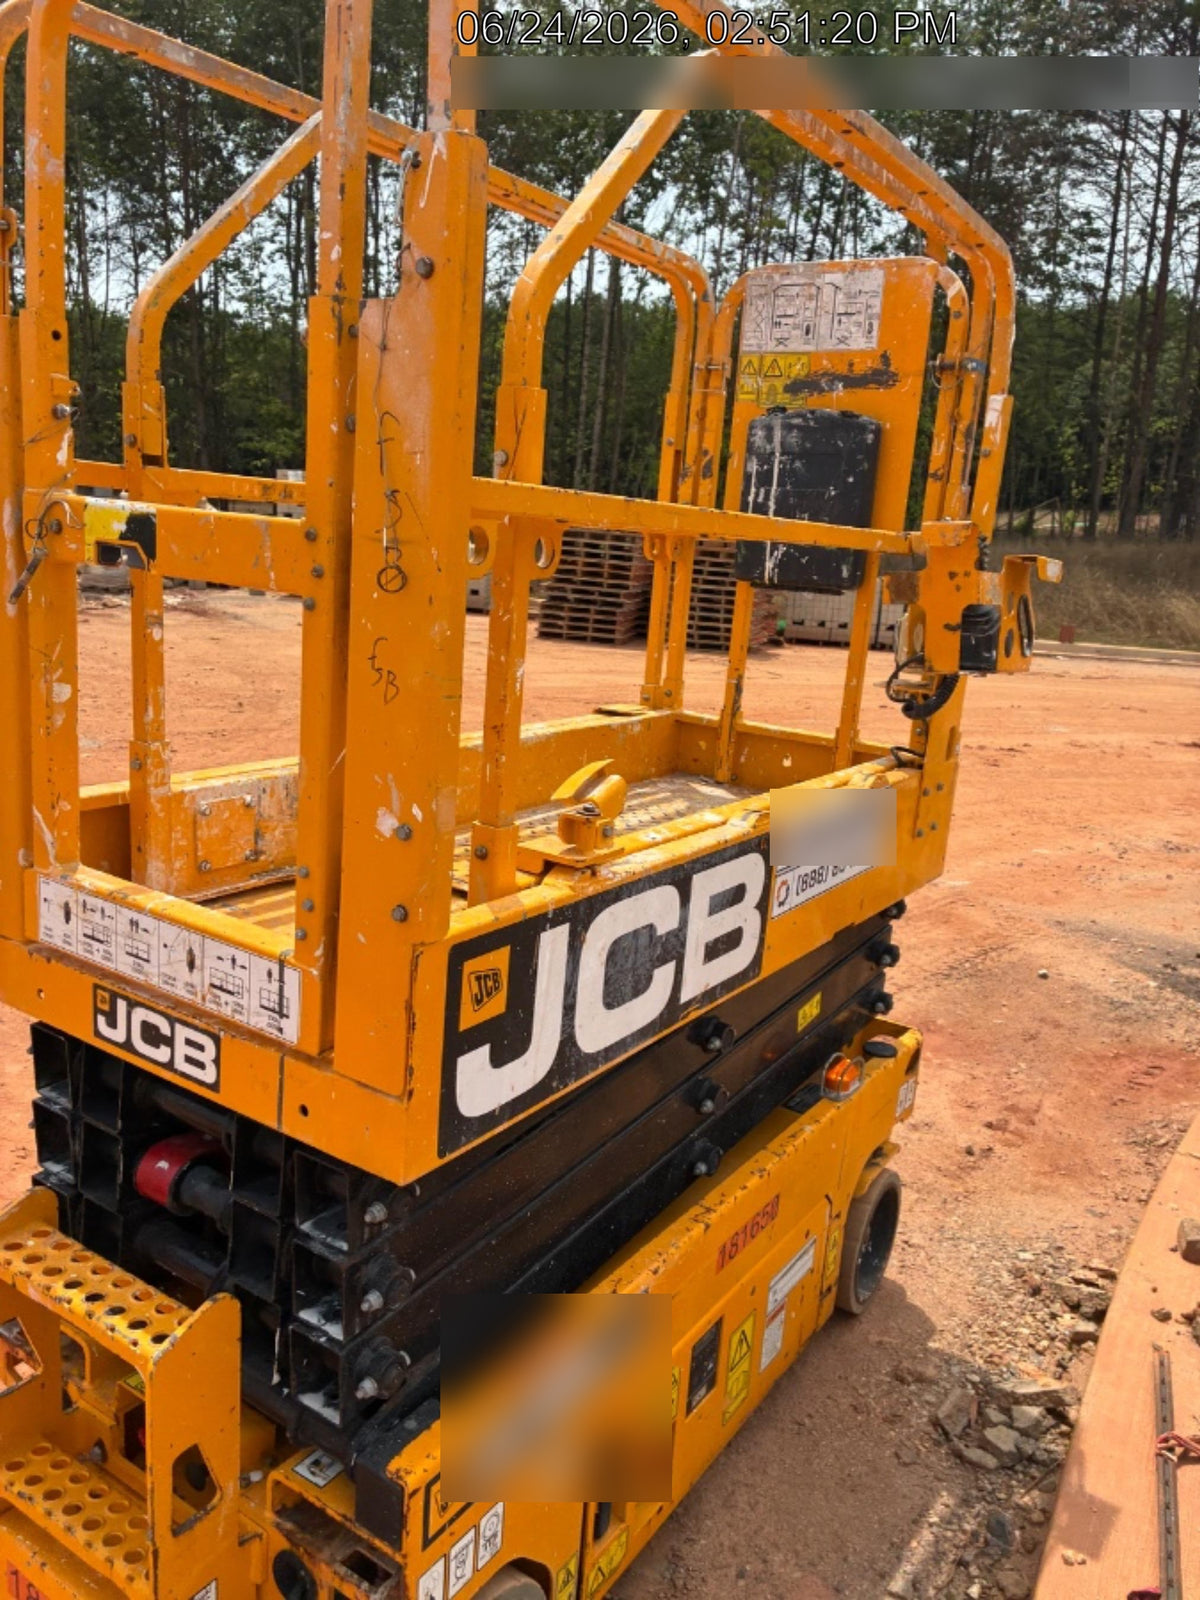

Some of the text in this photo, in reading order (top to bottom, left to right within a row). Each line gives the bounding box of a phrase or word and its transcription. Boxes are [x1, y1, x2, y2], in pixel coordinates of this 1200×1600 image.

[455, 852, 766, 1119] JCB
[473, 971, 500, 1006] JCB
[96, 997, 217, 1085] JCB
